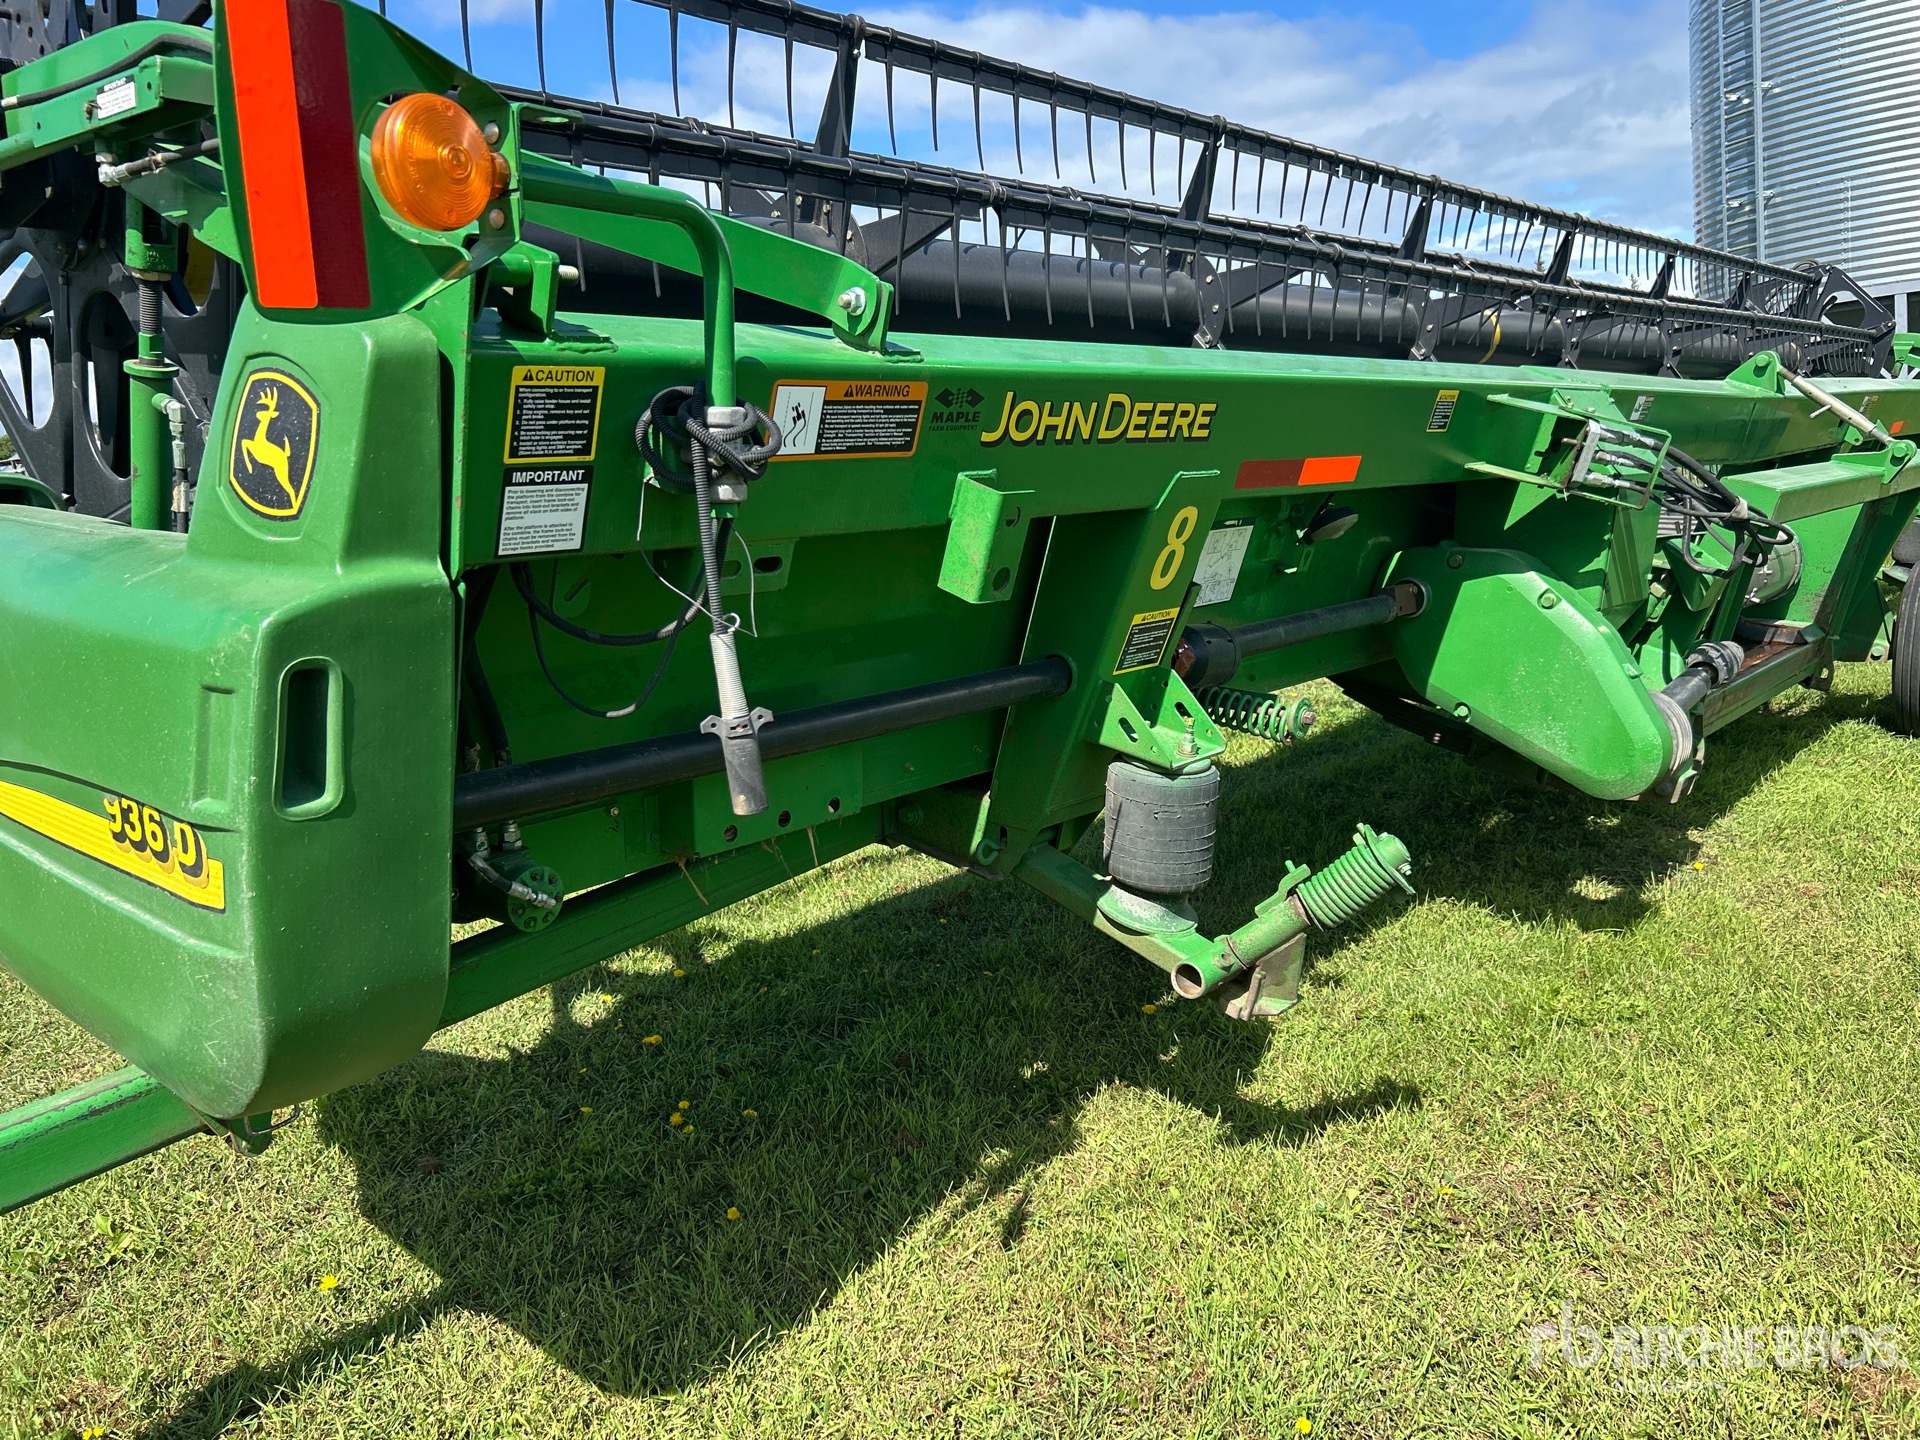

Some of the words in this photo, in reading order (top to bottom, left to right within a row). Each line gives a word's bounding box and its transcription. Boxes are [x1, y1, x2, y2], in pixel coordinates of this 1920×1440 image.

[536, 370, 595, 381] CAUTION
[855, 385, 910, 397] WARNING
[930, 411, 981, 424] MAPLE
[980, 391, 1099, 444] JOHN
[1097, 393, 1217, 442] DEERE
[512, 470, 585, 483] IMPORTANT
[1150, 505, 1199, 590] 8
[1146, 611, 1172, 621] CAUTION
